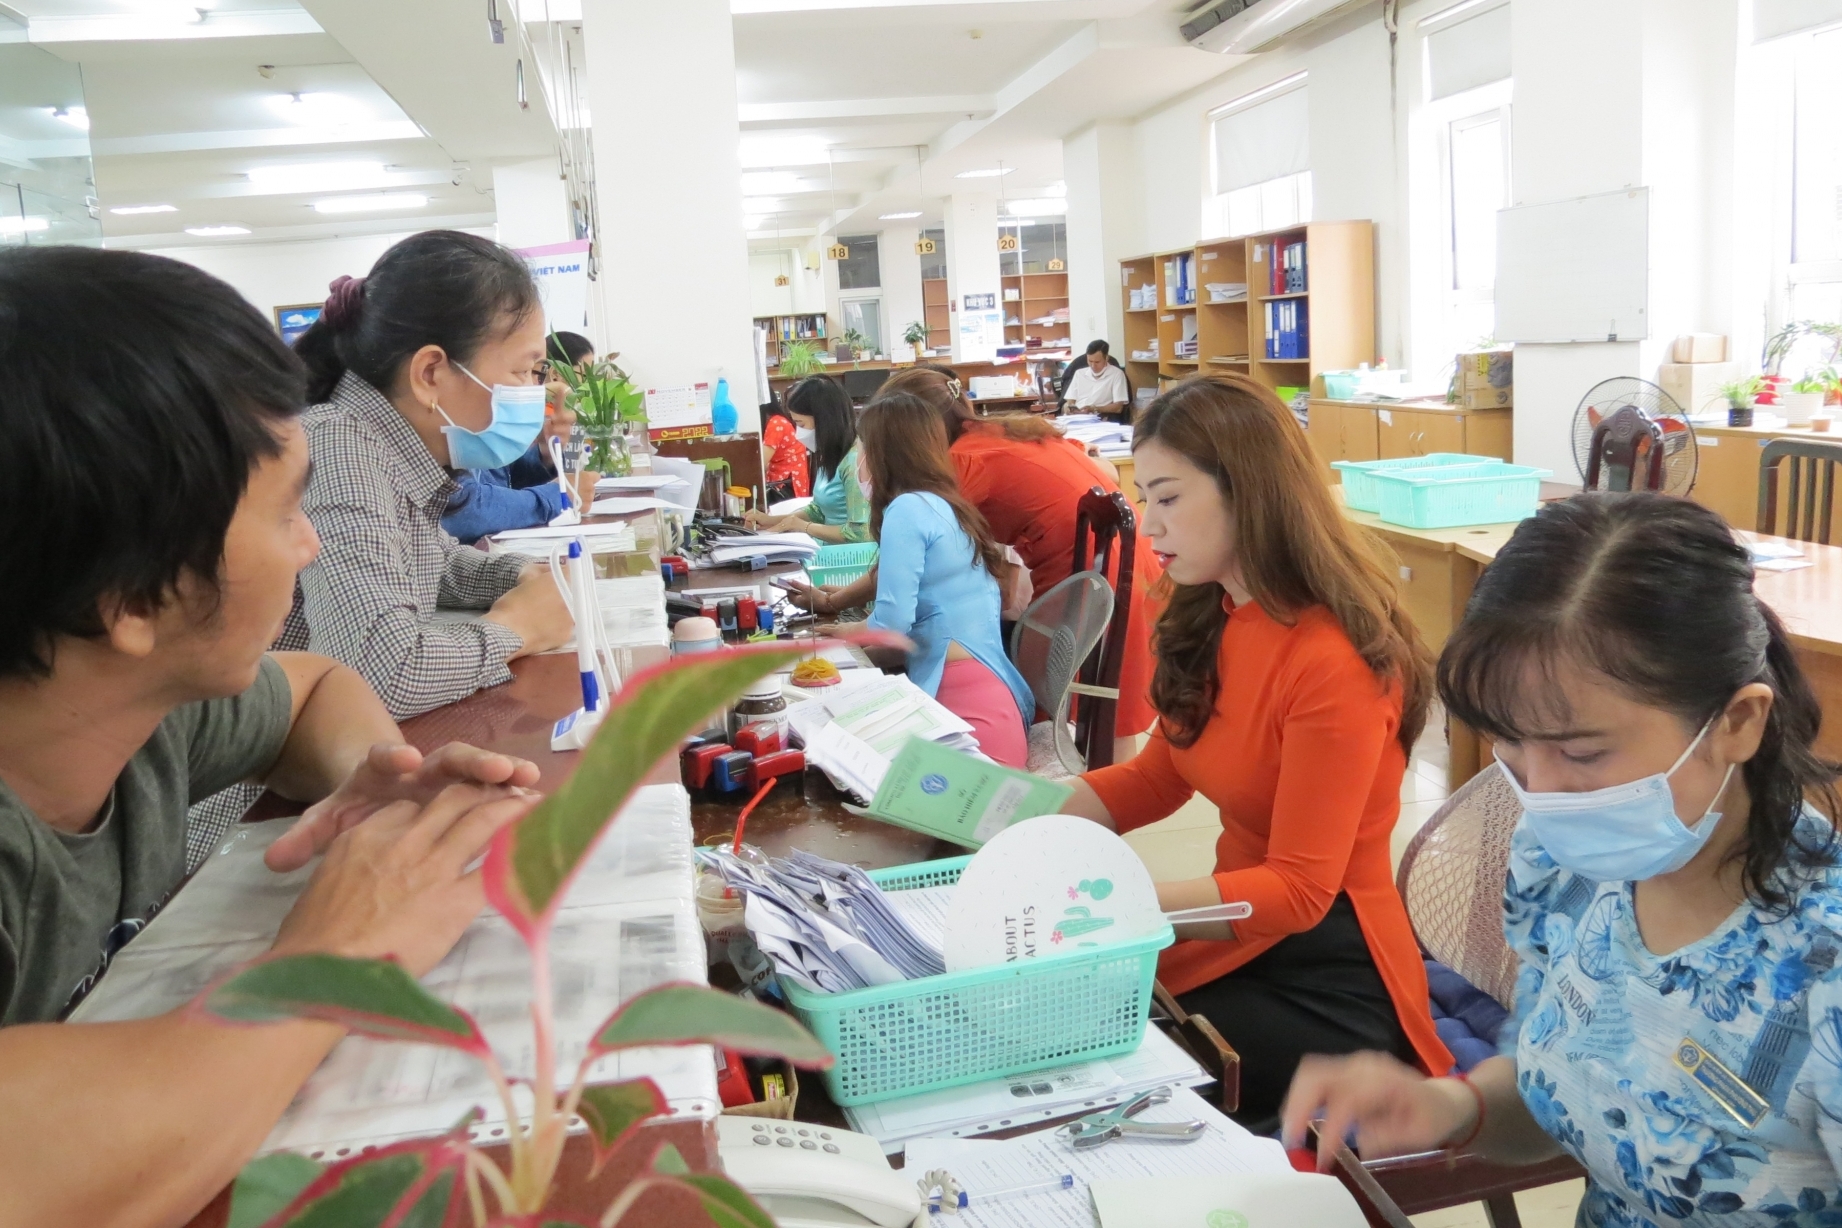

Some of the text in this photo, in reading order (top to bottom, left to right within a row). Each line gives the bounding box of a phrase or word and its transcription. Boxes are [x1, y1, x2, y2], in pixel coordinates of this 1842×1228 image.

[917, 242, 934, 253] 19
[1000, 239, 1015, 250] 20
[831, 248, 846, 258] 18
[557, 264, 580, 274] NAM
[1051, 261, 1061, 269] 29
[1023, 905, 1037, 958] ACTUS
[1557, 973, 1597, 1028] LONDON
